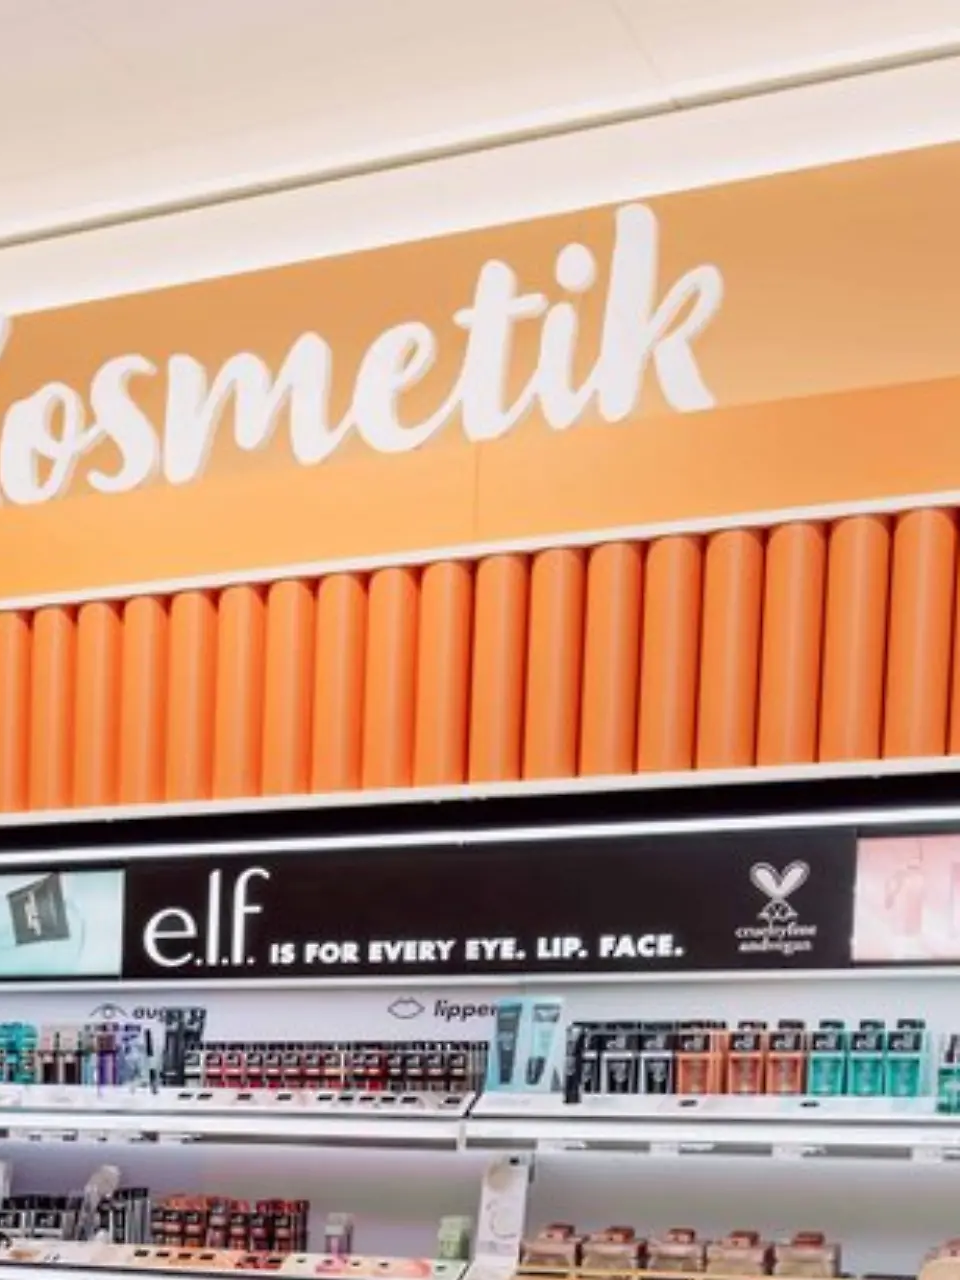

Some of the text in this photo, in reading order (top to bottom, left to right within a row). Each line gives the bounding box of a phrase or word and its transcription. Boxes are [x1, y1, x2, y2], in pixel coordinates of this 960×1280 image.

[270, 943, 295, 963] IS
[305, 942, 359, 963] FOR
[368, 939, 456, 961] EVERY
[465, 937, 526, 960] EYE.
[537, 936, 587, 959] LIP.
[599, 934, 683, 957] FACE.
